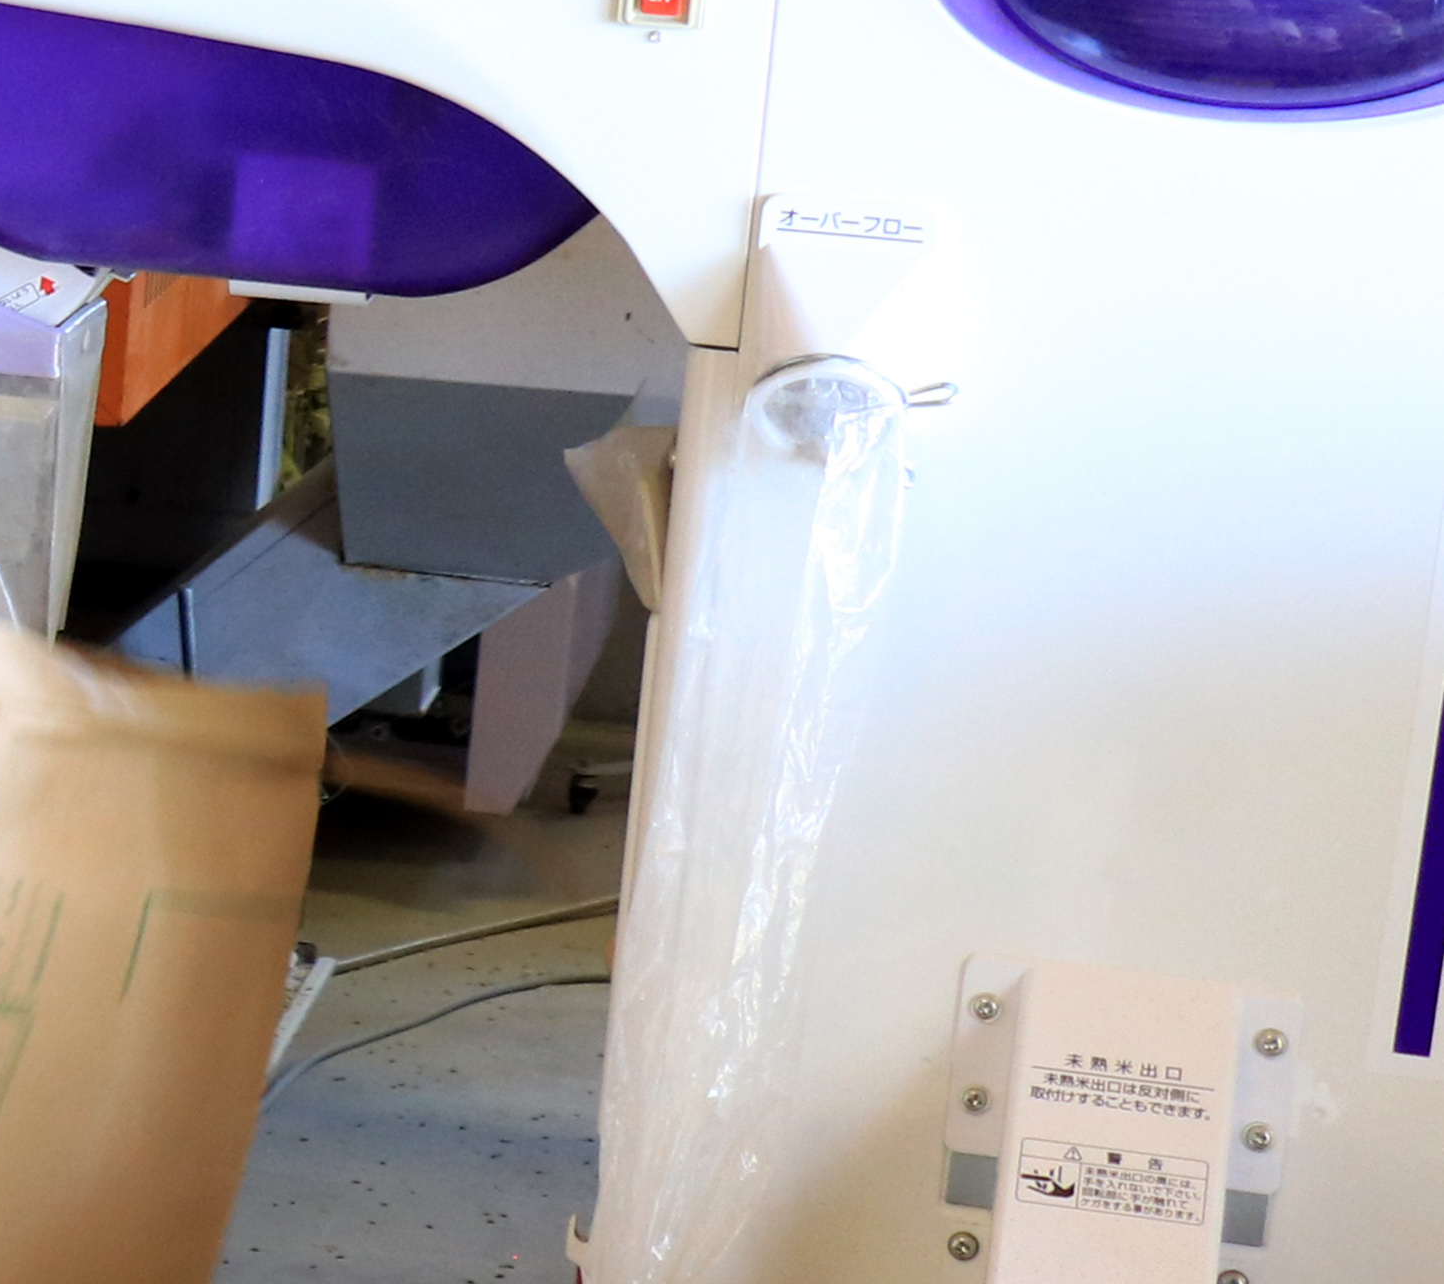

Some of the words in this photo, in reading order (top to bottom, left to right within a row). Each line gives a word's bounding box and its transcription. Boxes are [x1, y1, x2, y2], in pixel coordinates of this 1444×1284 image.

[778, 208, 923, 236] オーバーフロー
[1066, 1053, 1183, 1081] 未熟米出口
[1043, 1073, 1201, 1104] 未熟米出口は反対側に
[1030, 1086, 1211, 1121] 取付けすることもできます。
[1107, 1152, 1162, 1171] 警告
[1083, 1177, 1202, 1201] 手を入れないで下さい。
